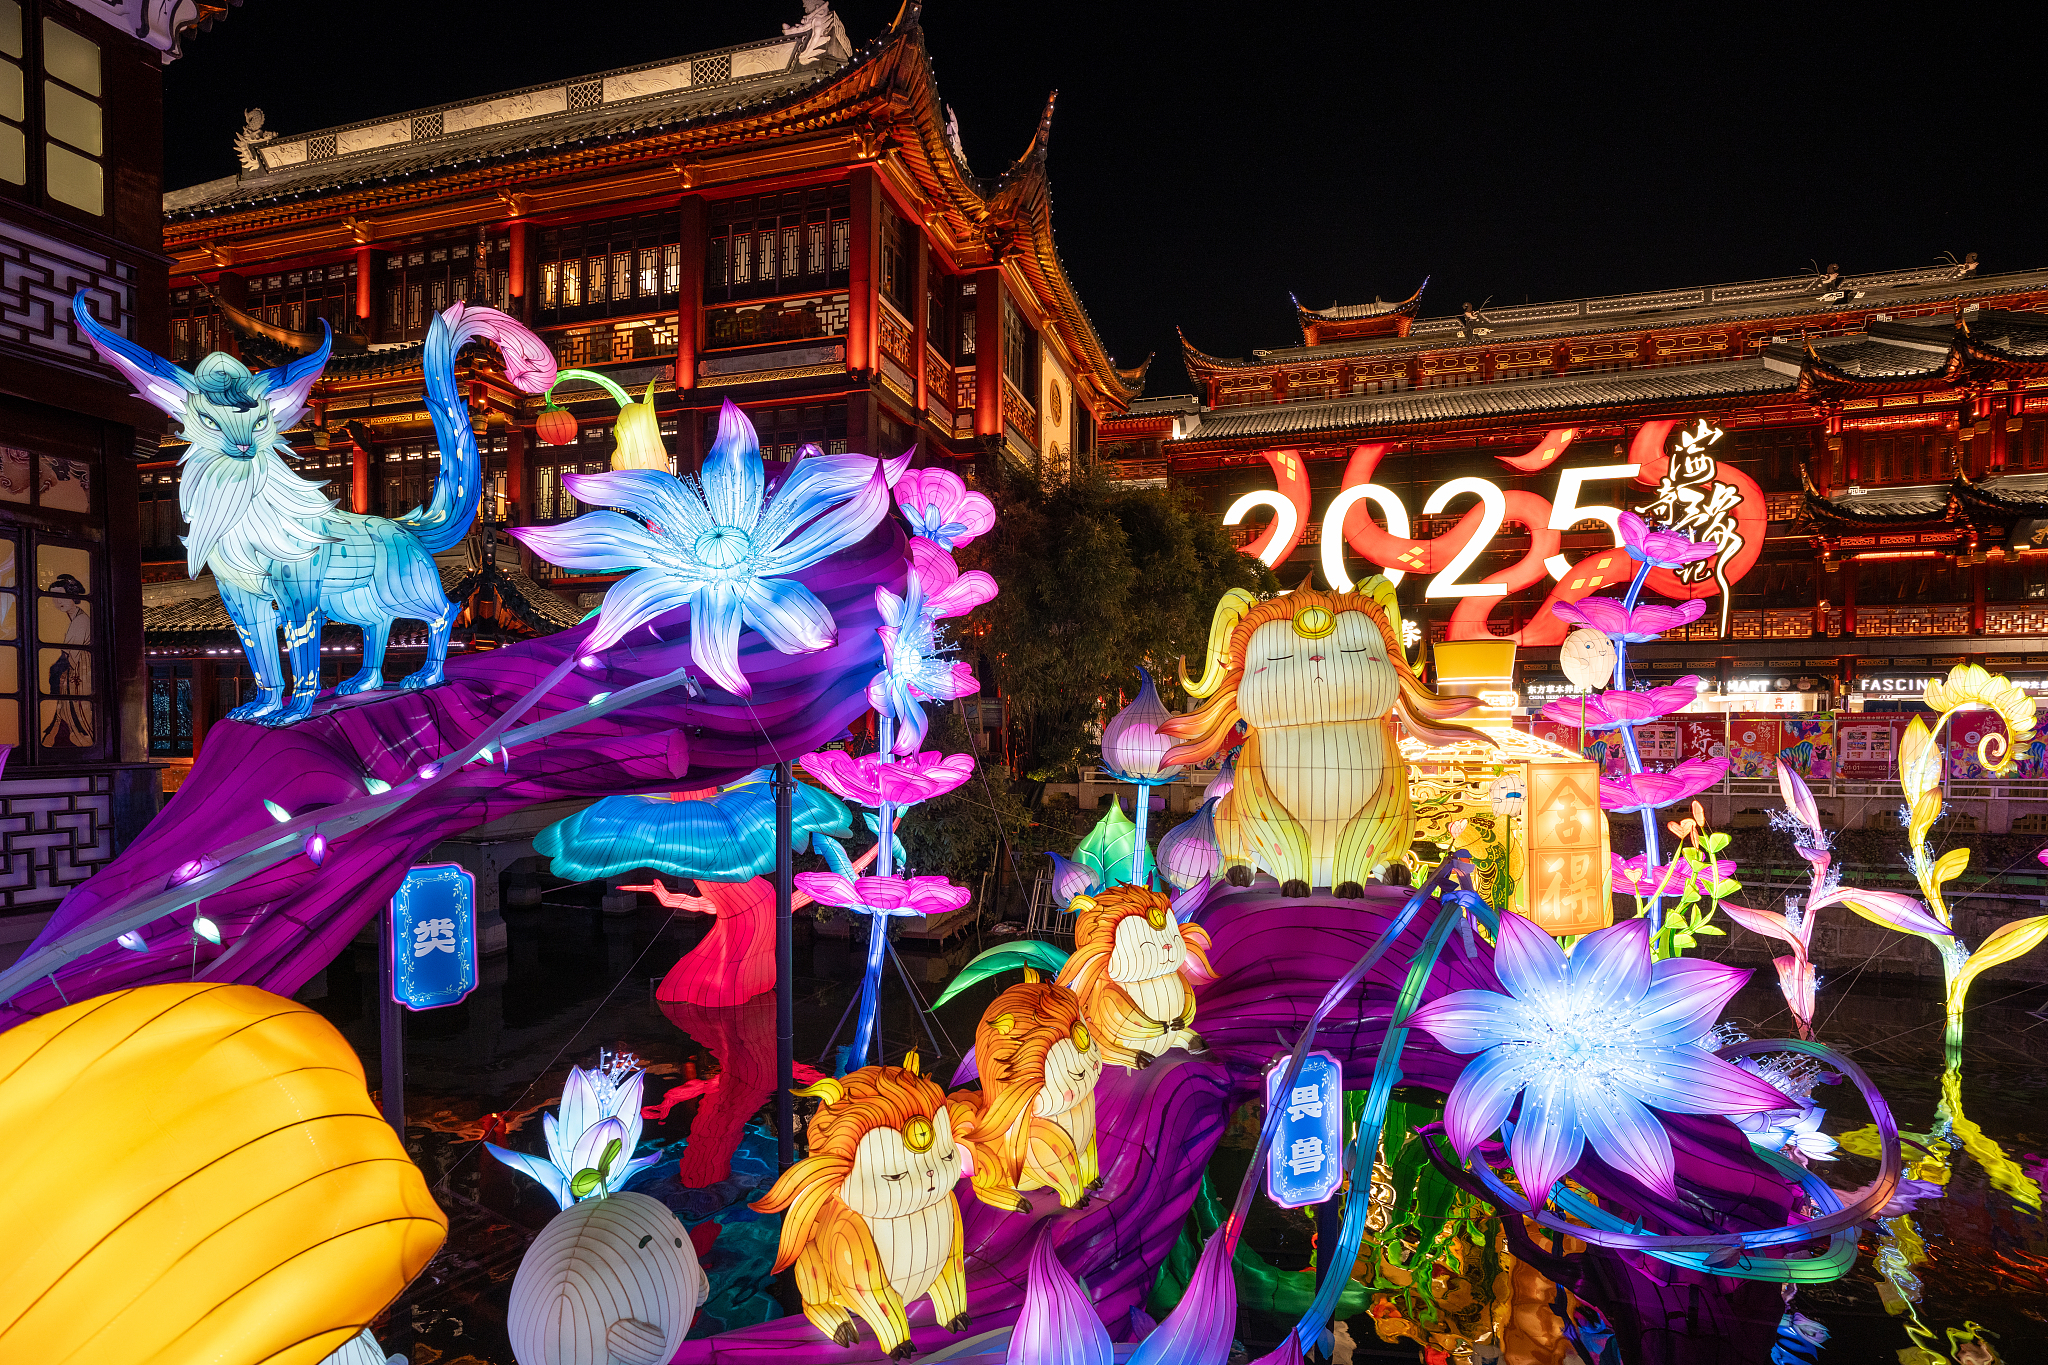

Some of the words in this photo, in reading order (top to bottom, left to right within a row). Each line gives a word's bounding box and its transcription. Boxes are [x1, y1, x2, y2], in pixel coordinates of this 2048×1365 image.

[1222, 462, 1643, 602] 2025
[1727, 680, 1770, 692] MART
[1861, 678, 1943, 691] FASCIN
[1537, 776, 1597, 923] 舍得
[413, 918, 456, 958] 类
[1286, 1083, 1326, 1176] 畏兽
